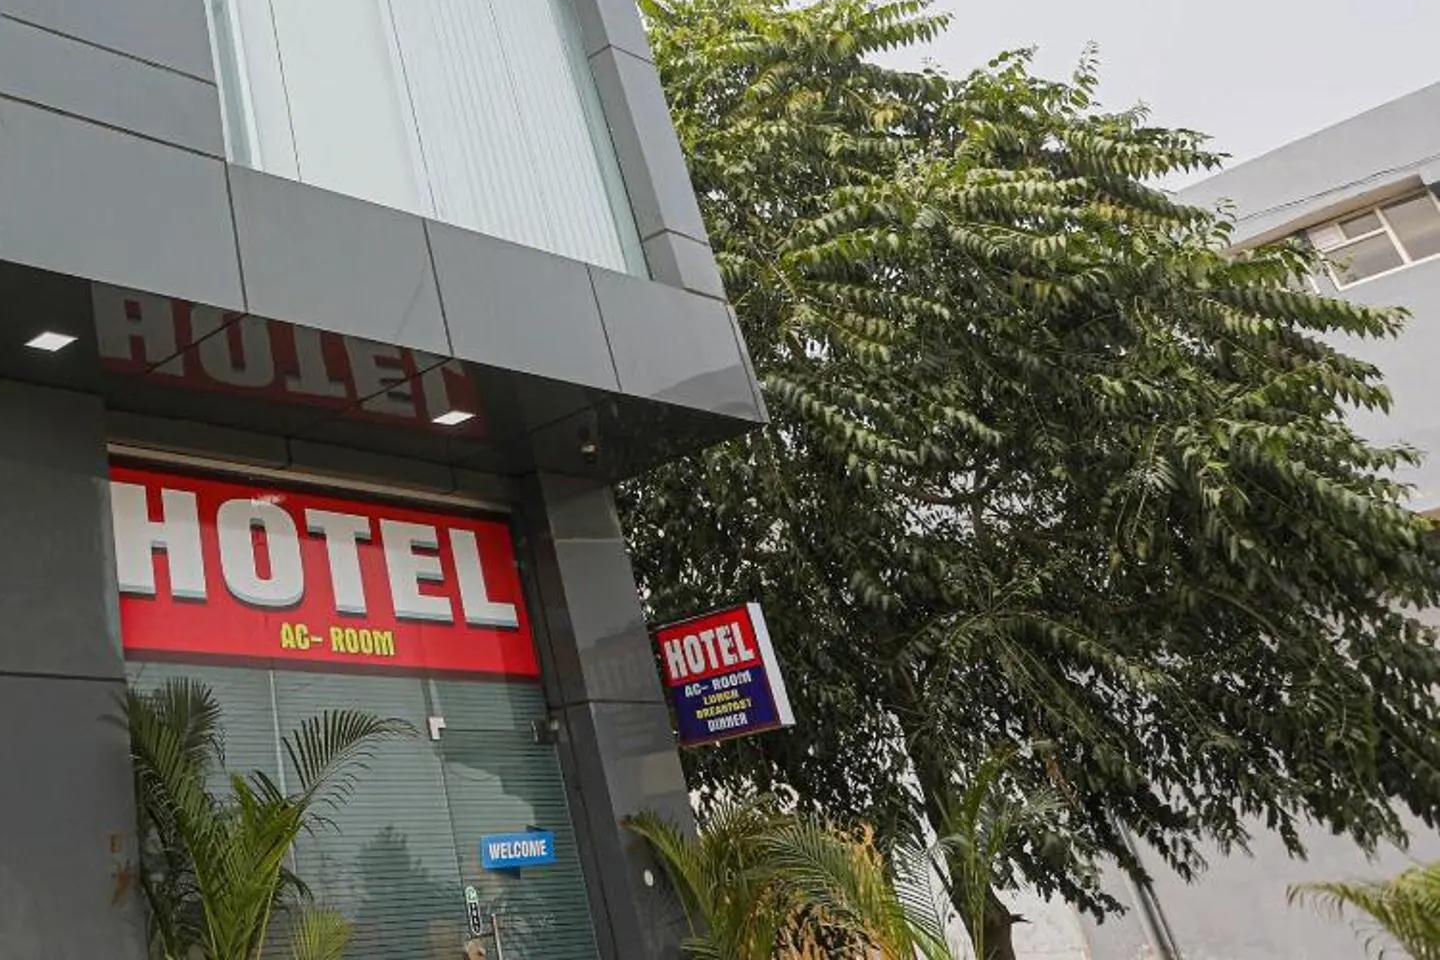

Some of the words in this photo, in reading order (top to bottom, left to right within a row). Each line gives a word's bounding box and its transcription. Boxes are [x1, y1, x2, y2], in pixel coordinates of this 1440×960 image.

[110, 482, 519, 628] HOTEL
[280, 622, 323, 650] AC-
[329, 626, 396, 656] ROOM
[664, 622, 755, 679] HOTEL
[712, 670, 752, 690] ROOM
[488, 839, 547, 860] WELCOME
